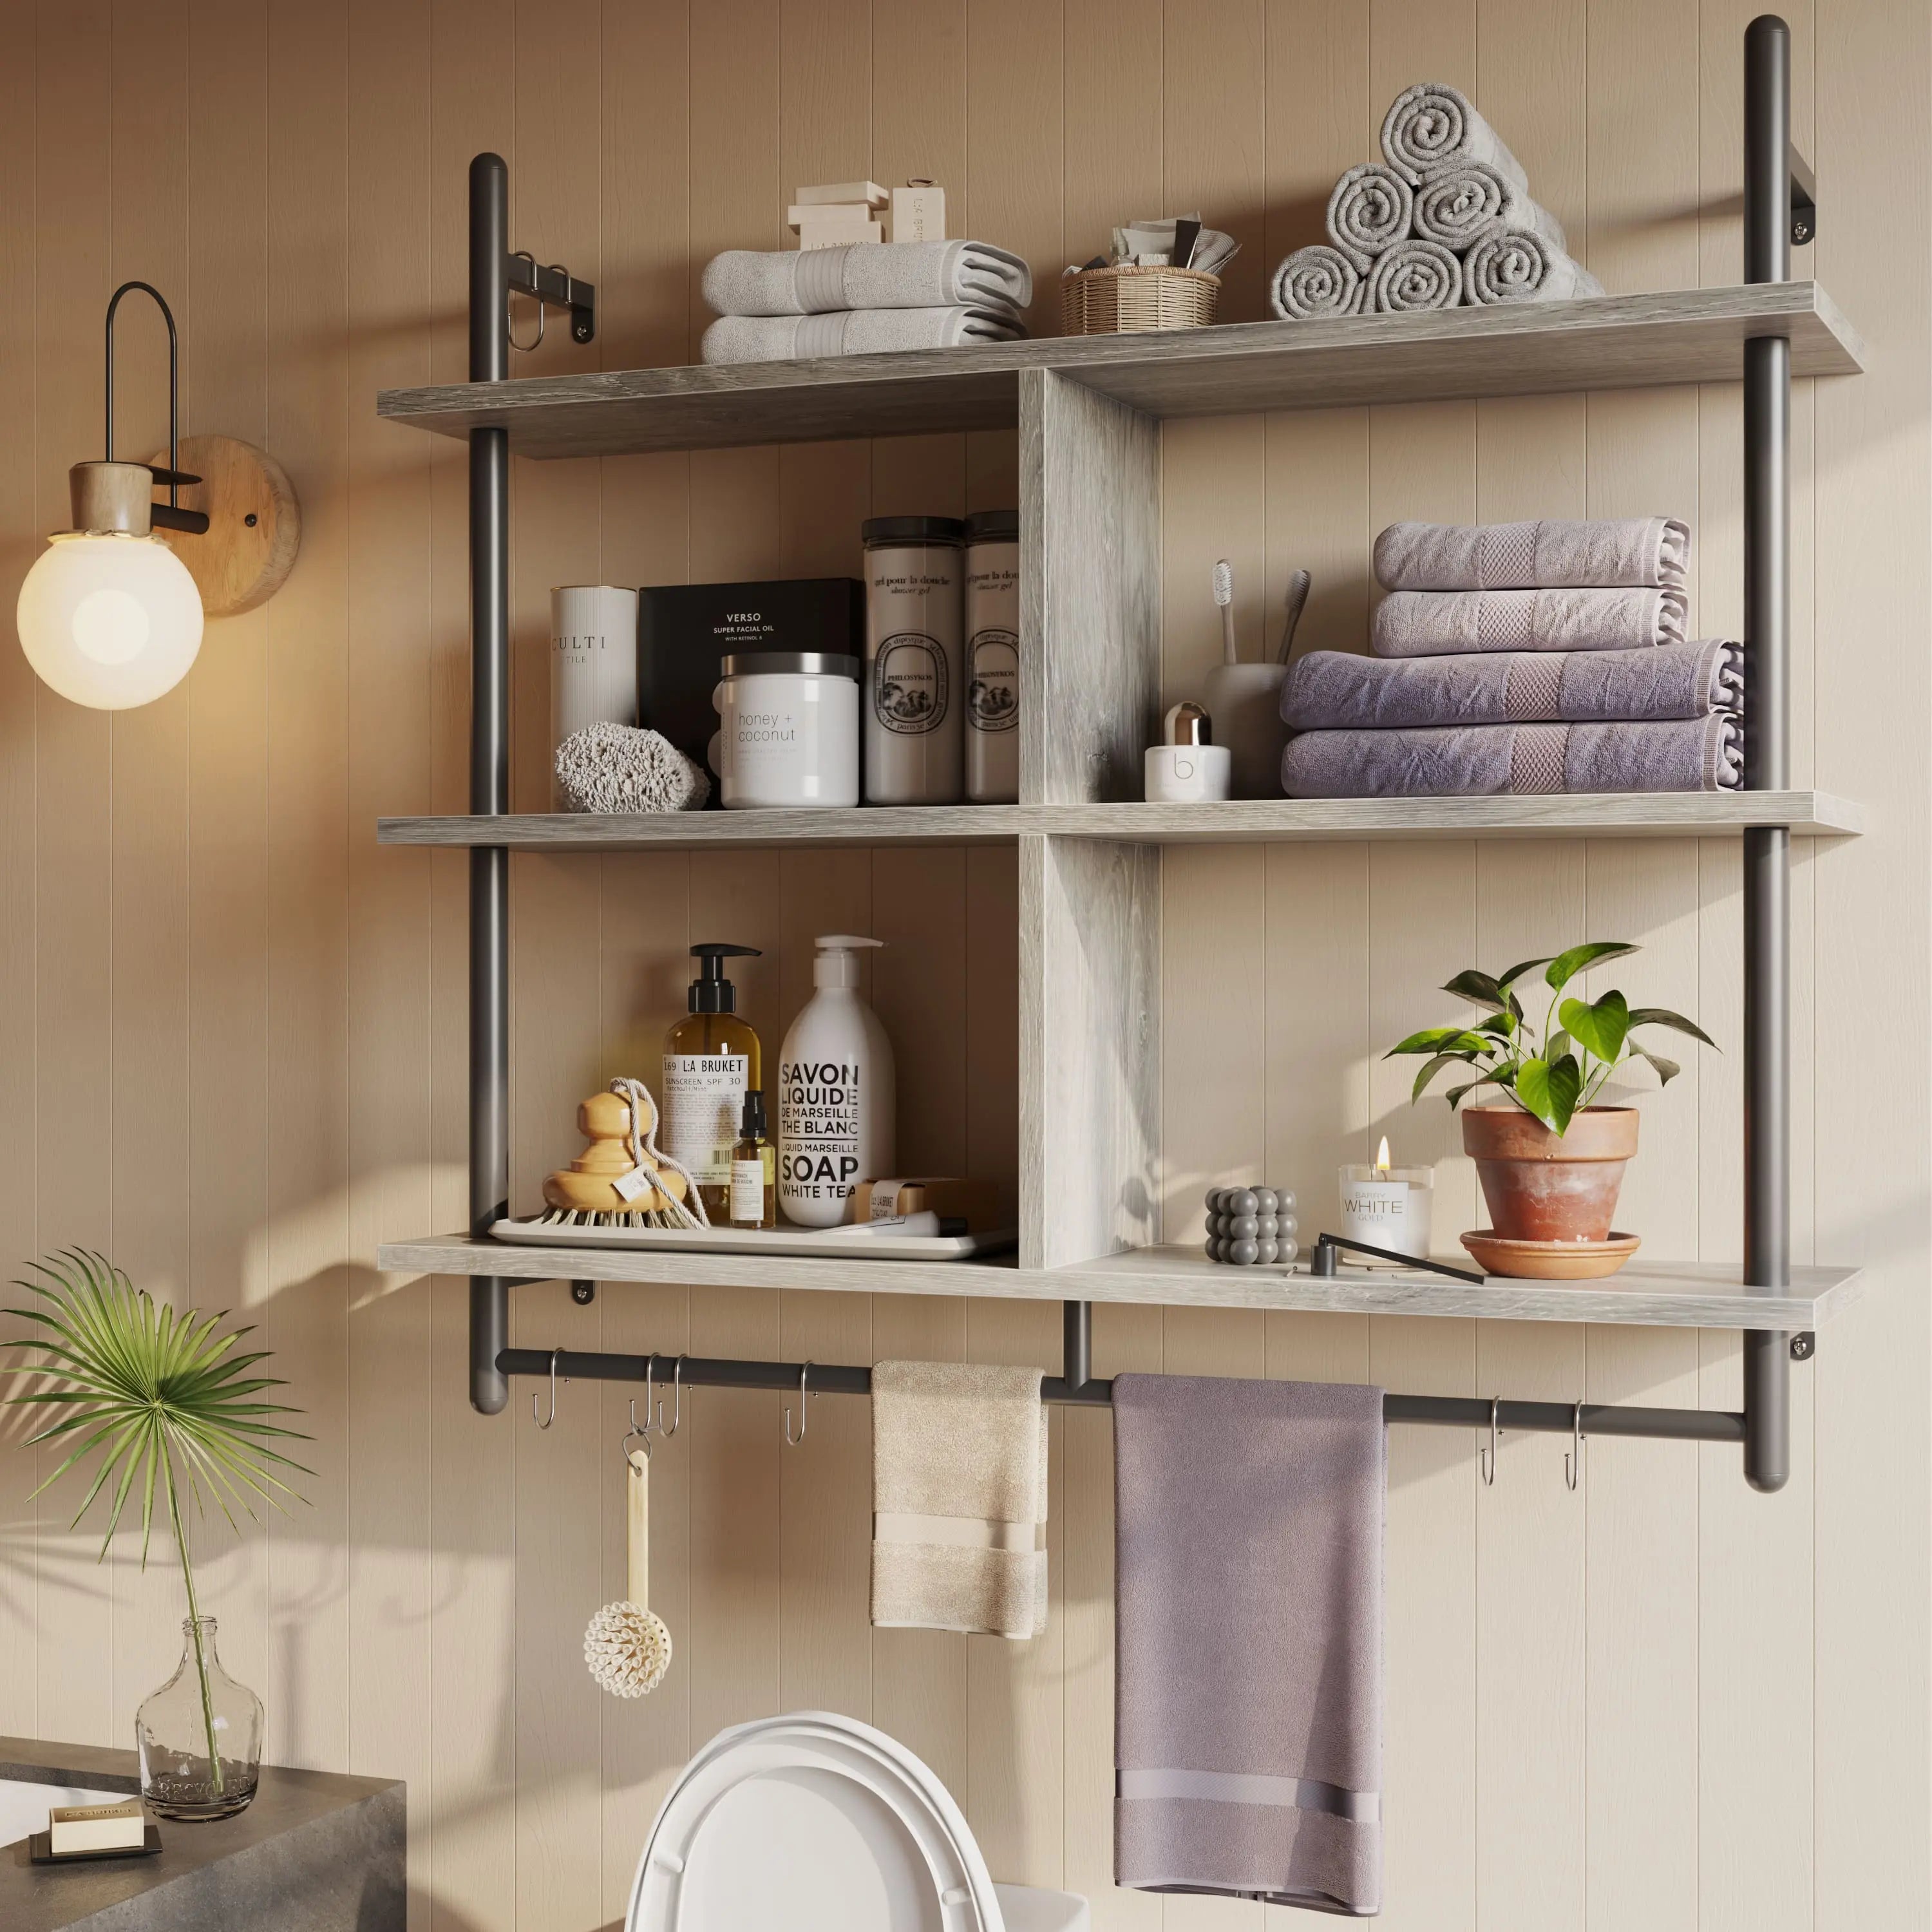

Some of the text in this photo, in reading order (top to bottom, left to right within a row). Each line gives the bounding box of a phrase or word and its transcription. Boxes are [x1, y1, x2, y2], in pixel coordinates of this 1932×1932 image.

[912, 219, 923, 242] BRU
[886, 576, 907, 587] pour
[910, 575, 918, 584] la
[918, 587, 931, 596] gel
[726, 612, 761, 623] VERSO
[552, 636, 605, 651] CULTI
[561, 656, 587, 664] TILE
[739, 712, 779, 728] honey
[739, 729, 796, 743] coconut
[1174, 753, 1194, 780] b
[664, 1059, 743, 1072] 169 L:A BRUKET
[665, 1077, 702, 1086] SUNSCREEN
[729, 1077, 741, 1085] 30
[782, 1063, 858, 1086] SAVON
[782, 1087, 858, 1106] LIQUIDE
[782, 1107, 858, 1119] DE MARSEILLE
[805, 1121, 858, 1135] BLANC
[782, 1143, 858, 1153] LIQUID MARSEILLE
[782, 1154, 858, 1182] SOAP
[782, 1183, 856, 1199] WHITE TEA
[1344, 1198, 1403, 1214] WHITE
[1358, 1213, 1383, 1222] GOLD
